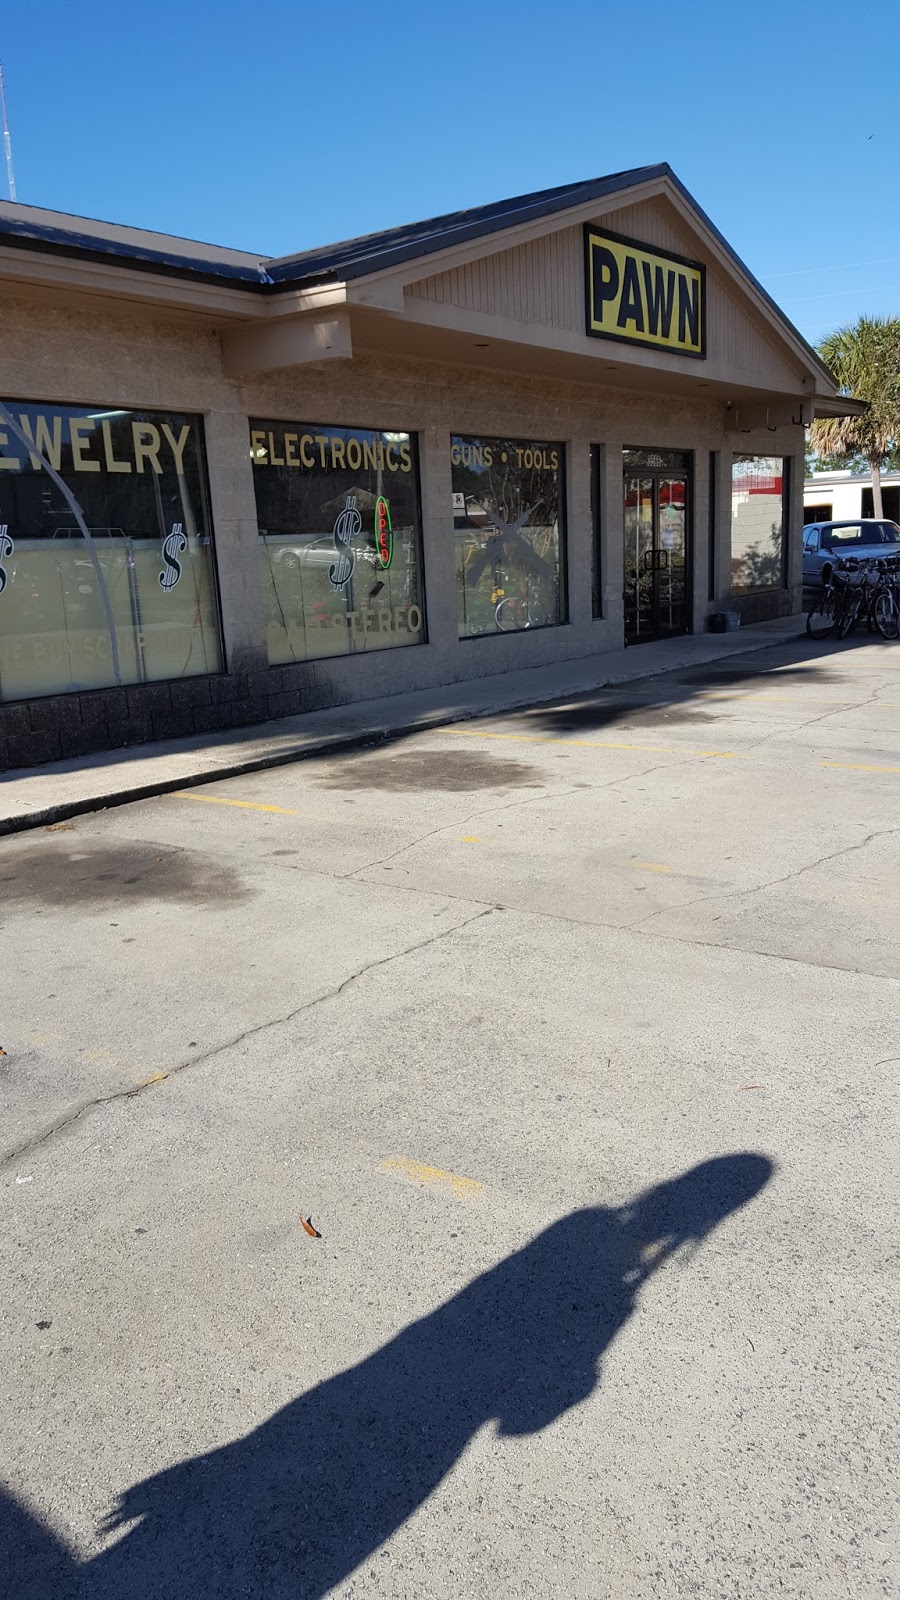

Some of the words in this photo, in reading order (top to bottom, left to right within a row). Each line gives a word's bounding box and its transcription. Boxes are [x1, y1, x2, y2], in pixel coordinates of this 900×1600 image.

[592, 243, 699, 346] PAWN
[251, 430, 412, 473] ELECTRONICS
[450, 445, 493, 467] GUNS
[516, 448, 558, 470] TOOLS
[378, 502, 389, 562] OPEN
[332, 604, 422, 641] STEREO
